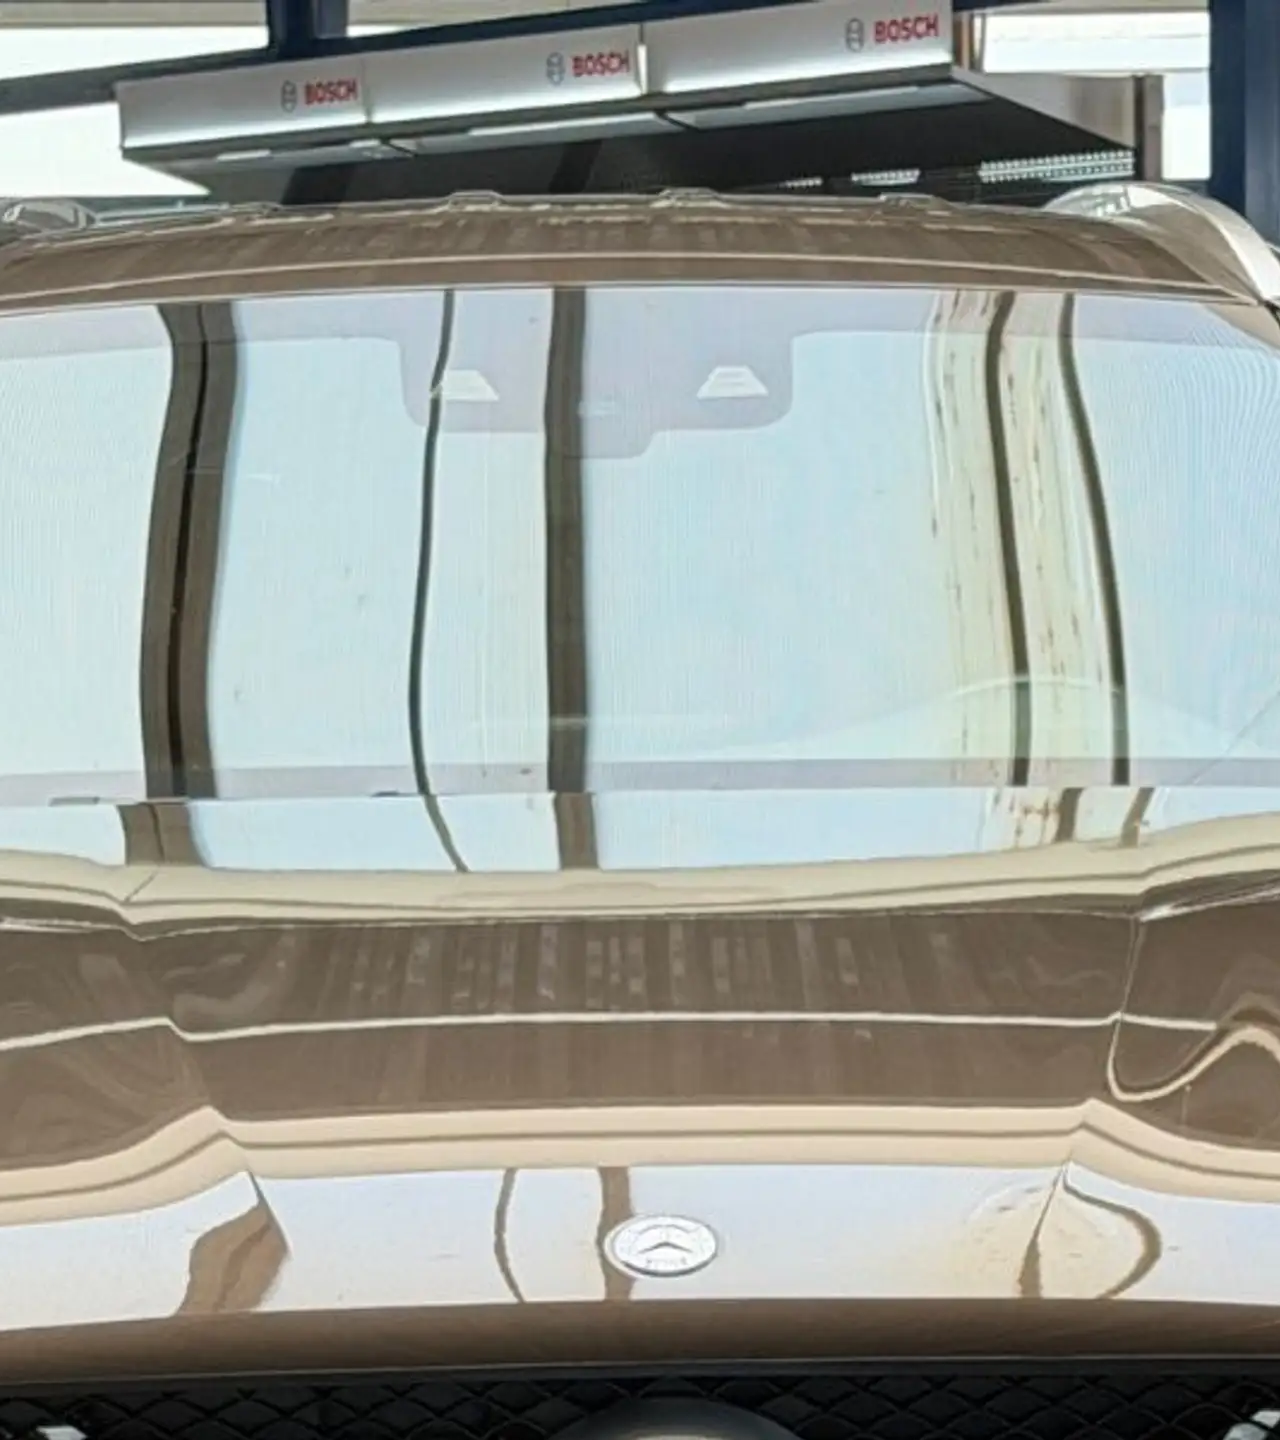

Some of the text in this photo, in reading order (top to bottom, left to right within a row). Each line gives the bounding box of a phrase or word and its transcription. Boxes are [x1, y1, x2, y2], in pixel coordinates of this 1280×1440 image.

[874, 15, 939, 43] BOSCH
[571, 50, 629, 77] BOSCH
[304, 79, 357, 105] BOSCH
